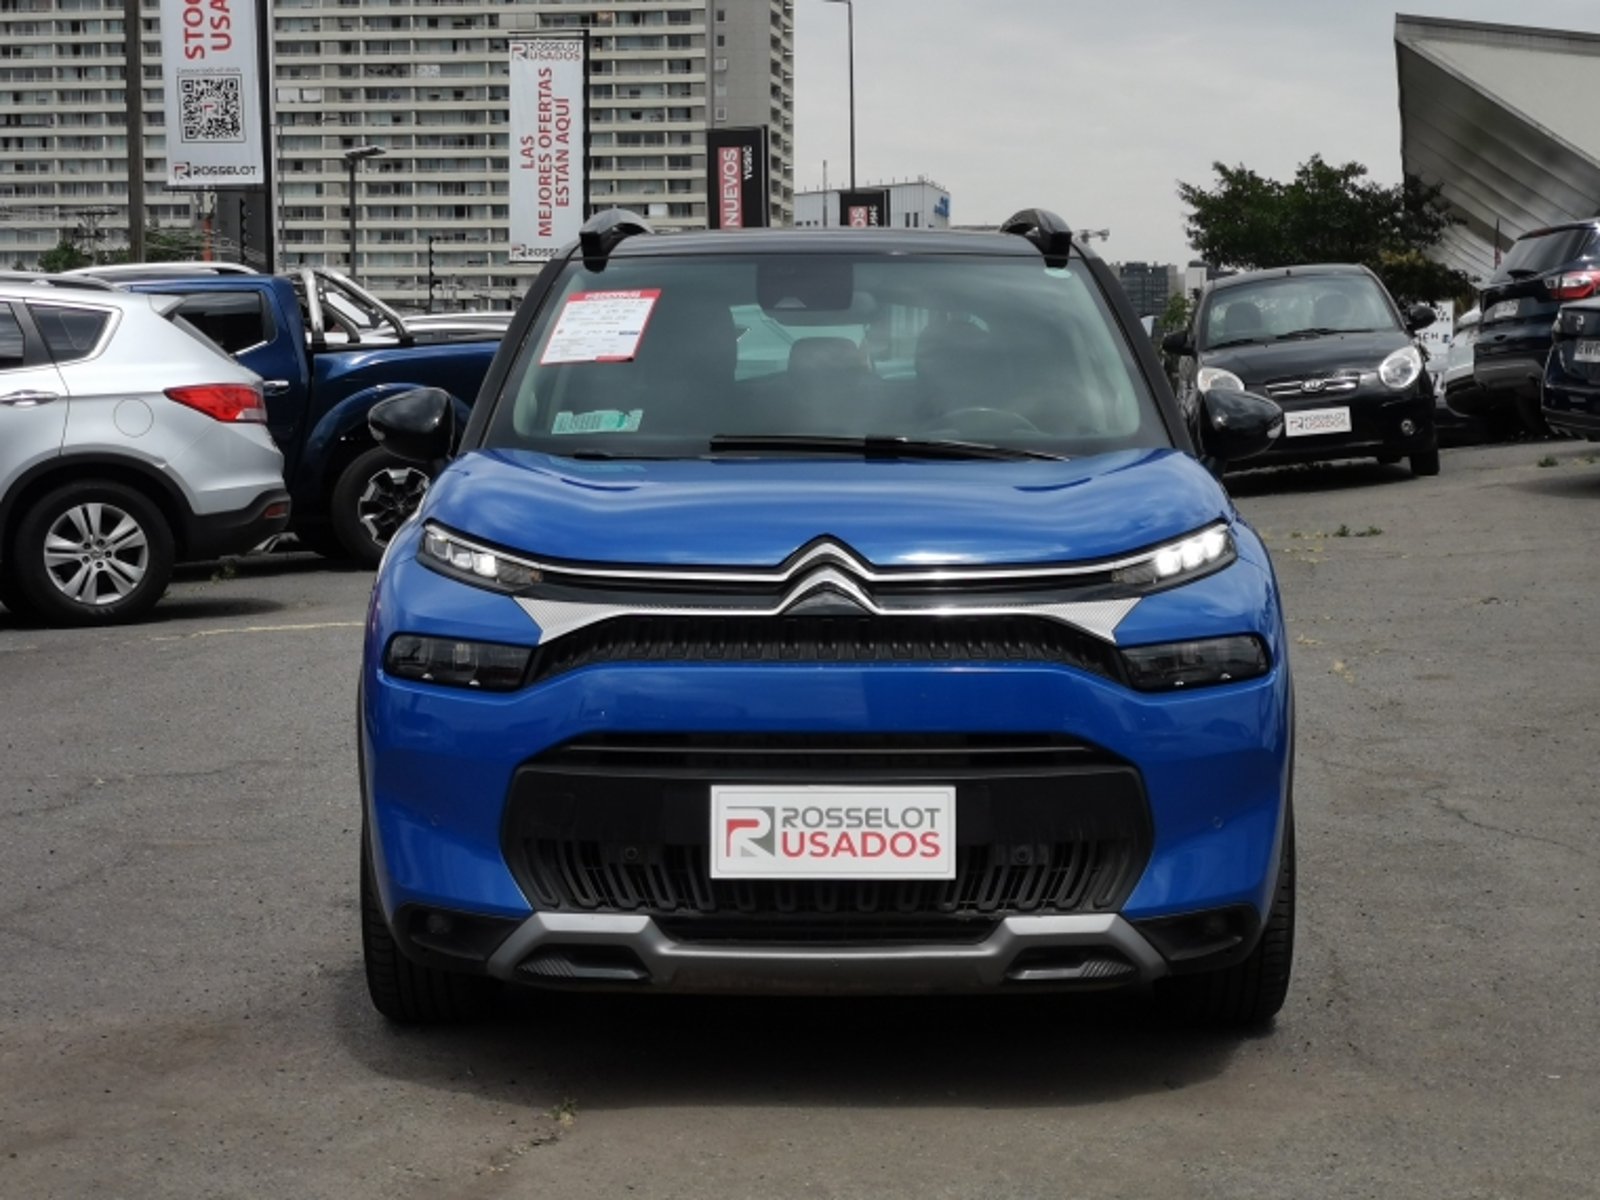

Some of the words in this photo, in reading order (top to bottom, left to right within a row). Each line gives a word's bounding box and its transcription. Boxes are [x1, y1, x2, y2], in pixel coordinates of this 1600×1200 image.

[183, 0, 205, 60] STO
[538, 67, 552, 148] OFERTAS
[553, 98, 571, 143] AQUÍ
[193, 165, 256, 175] ROSSELOT
[520, 135, 534, 169] LAS
[538, 154, 552, 237] MEJORES
[553, 150, 569, 207] ESTÁN
[723, 149, 739, 227] NUEVOS
[782, 807, 941, 828] ROSSELOT
[782, 831, 941, 858] USADOS
